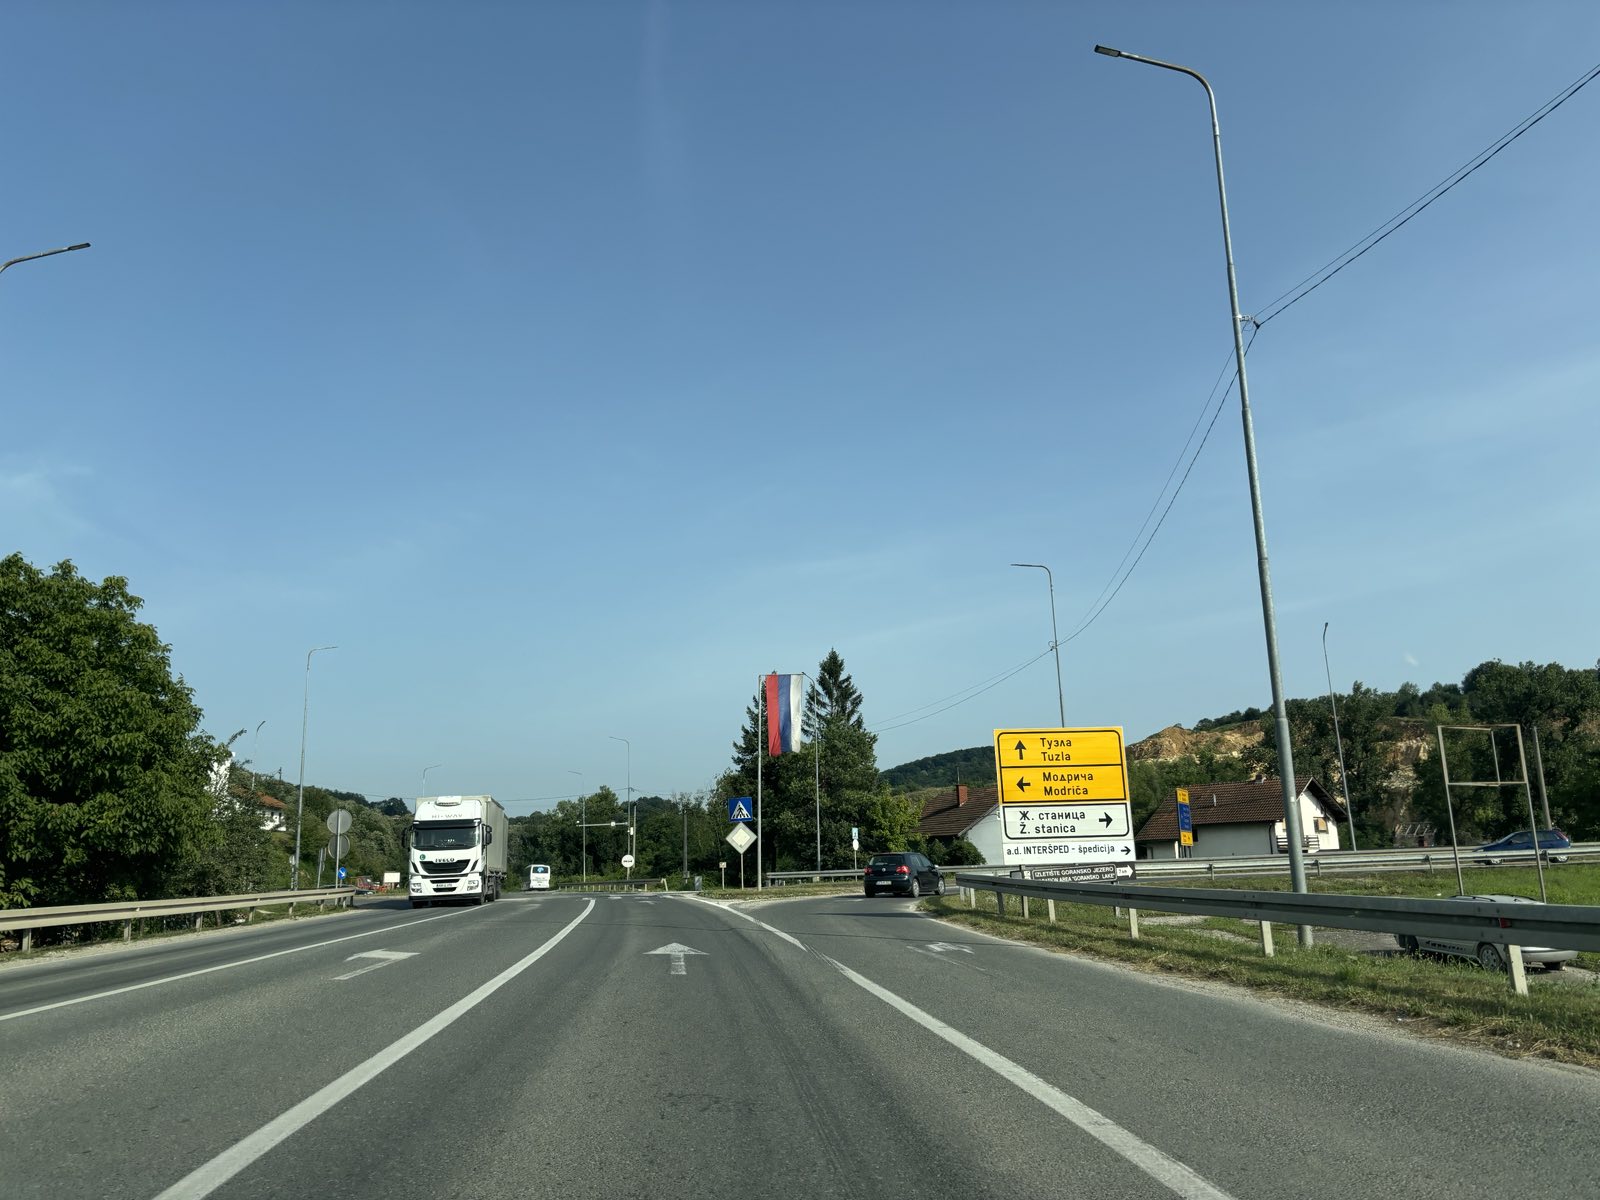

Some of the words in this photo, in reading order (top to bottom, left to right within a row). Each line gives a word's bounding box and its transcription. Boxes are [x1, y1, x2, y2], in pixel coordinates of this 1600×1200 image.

[1040, 737, 1072, 749] Тузла
[1041, 751, 1071, 761] Tuzla
[1042, 772, 1094, 783] Модрича
[1043, 786, 1088, 796] Modriča
[1019, 810, 1035, 821] Ж.
[1038, 811, 1086, 821] станица
[1019, 821, 1031, 834] Ž.
[1035, 823, 1076, 834] stanica
[1006, 847, 1021, 855] a.d.
[1023, 844, 1069, 855] INTERŠPED
[1078, 843, 1115, 855] špedicija
[1061, 867, 1091, 876] GORANSKO
